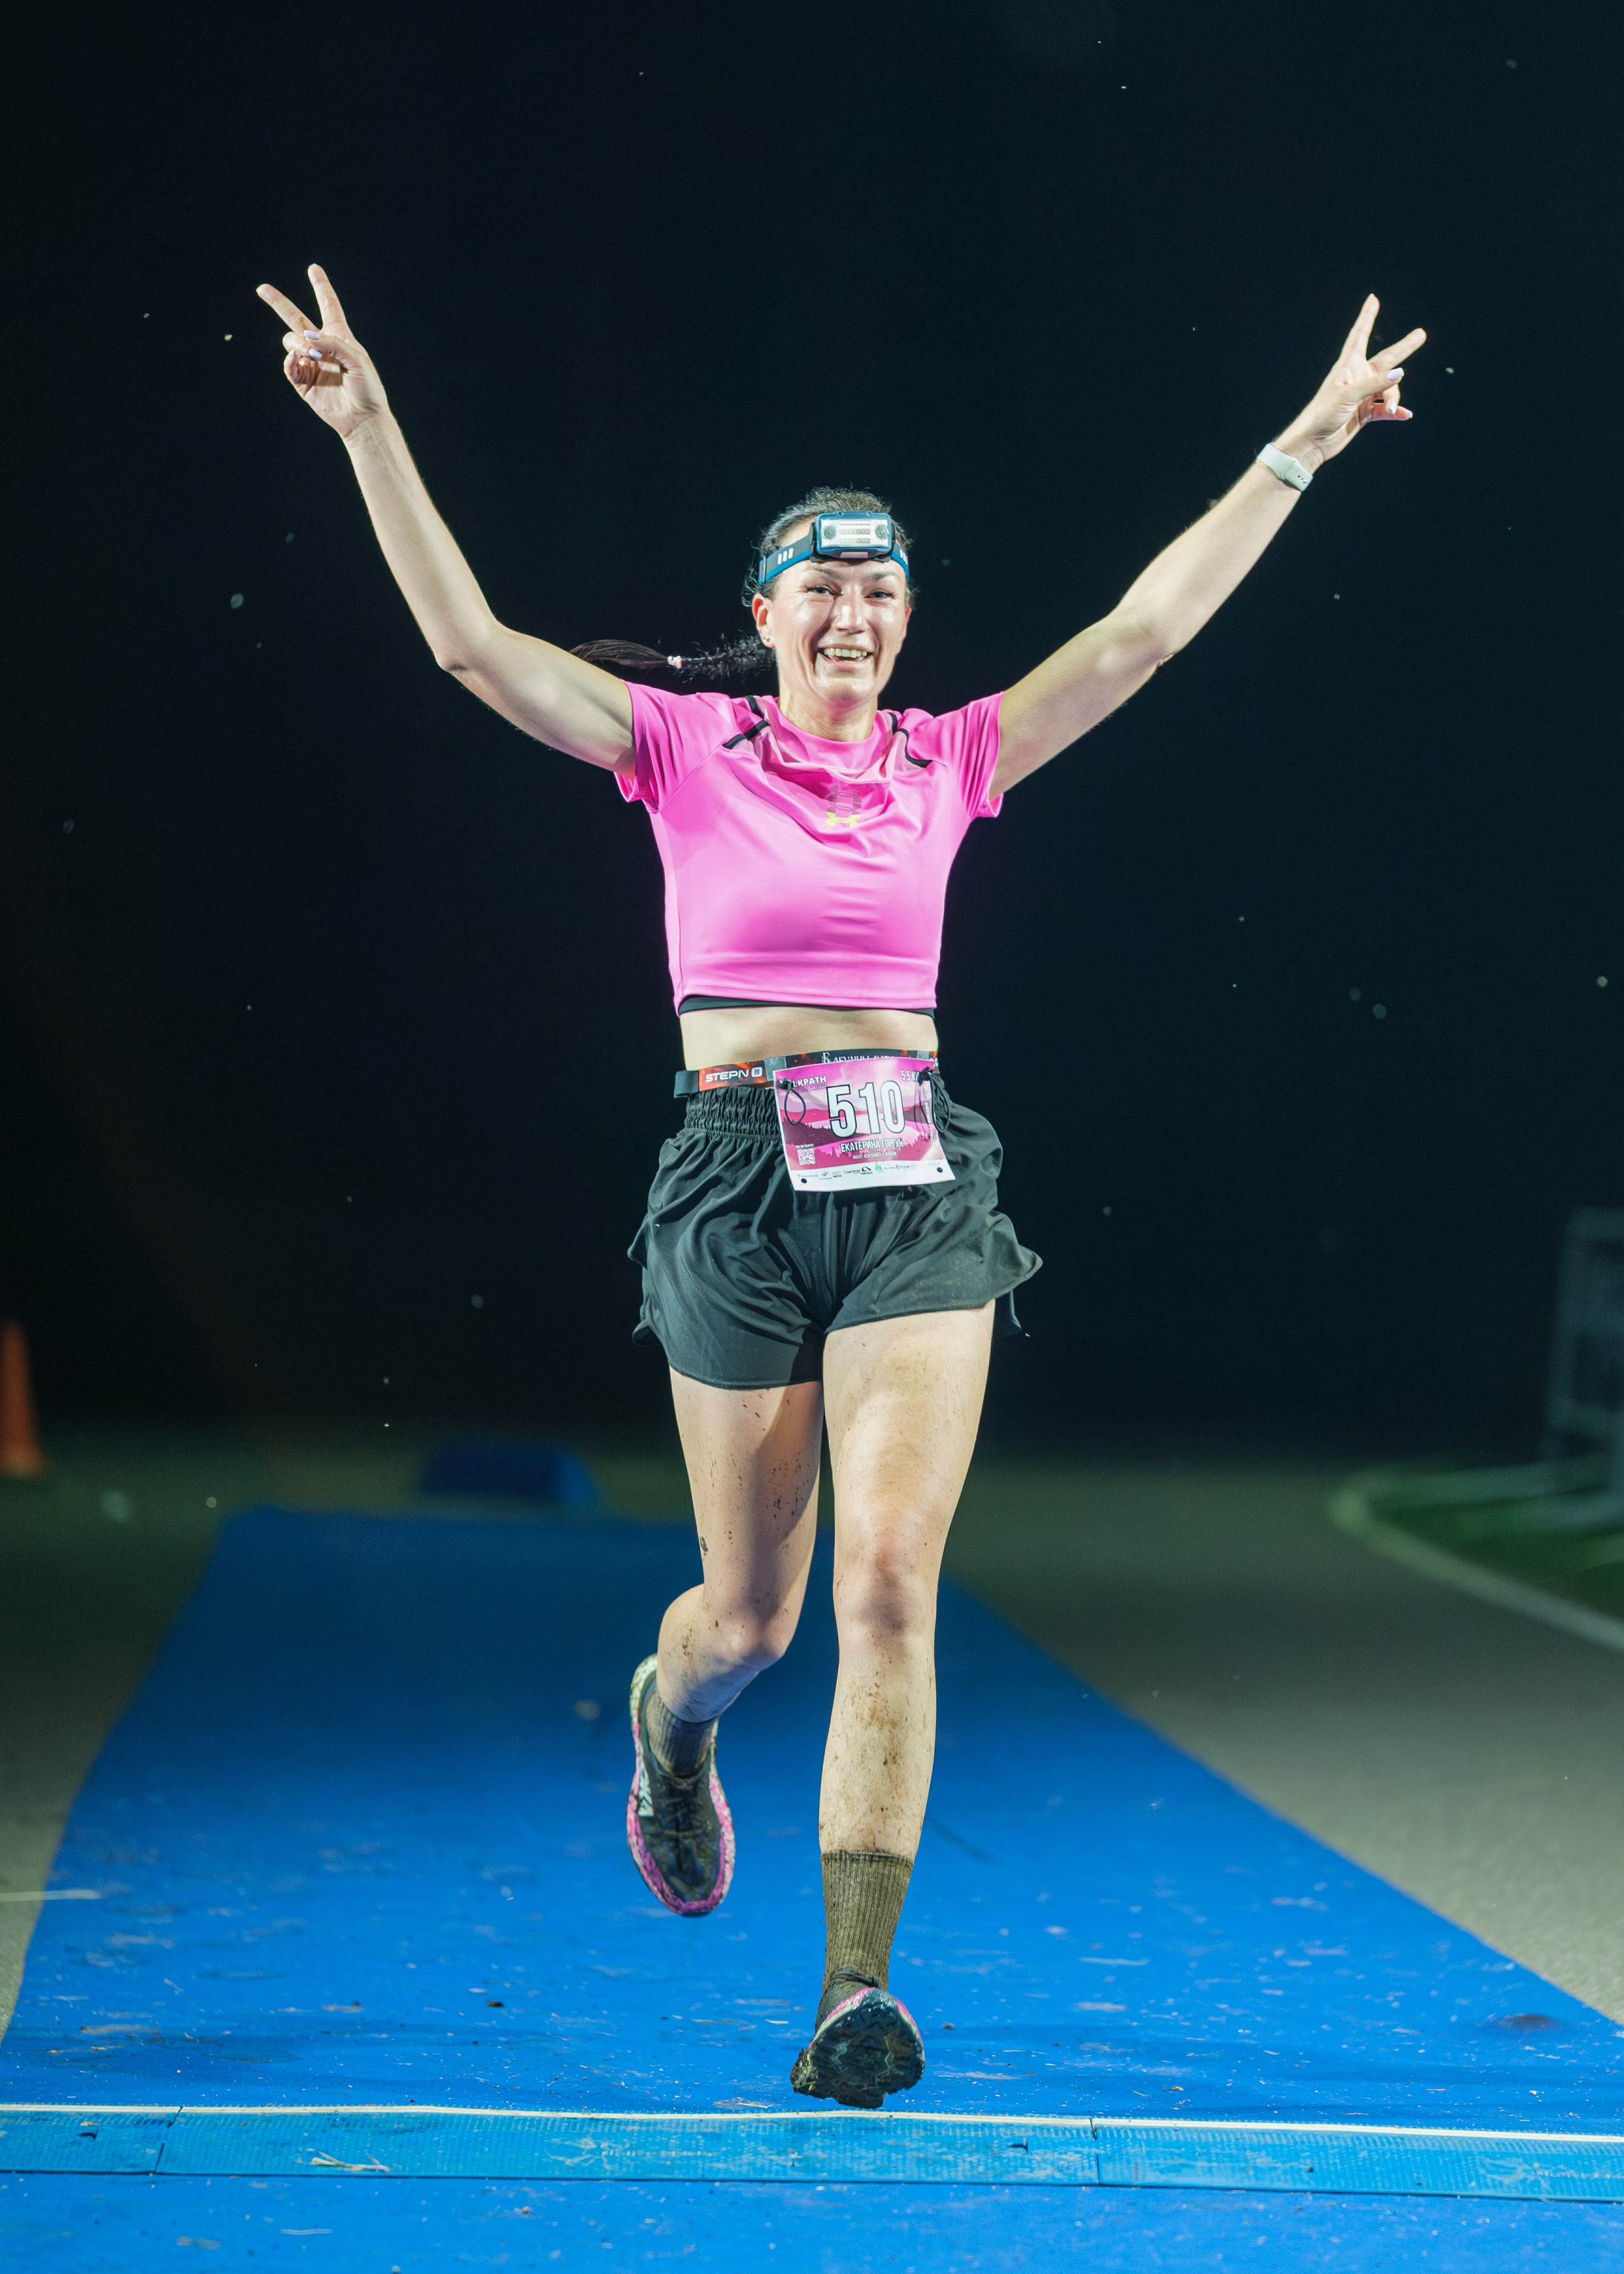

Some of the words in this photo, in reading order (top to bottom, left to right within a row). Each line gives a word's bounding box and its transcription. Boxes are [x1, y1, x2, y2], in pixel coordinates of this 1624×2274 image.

[705, 1069, 749, 1083] STEPN
[792, 1075, 827, 1088] LKPATH
[901, 1070, 911, 1082] 5.5
[826, 1080, 905, 1138] 510
[841, 1140, 881, 1153] ЕКАТЕРИНА
